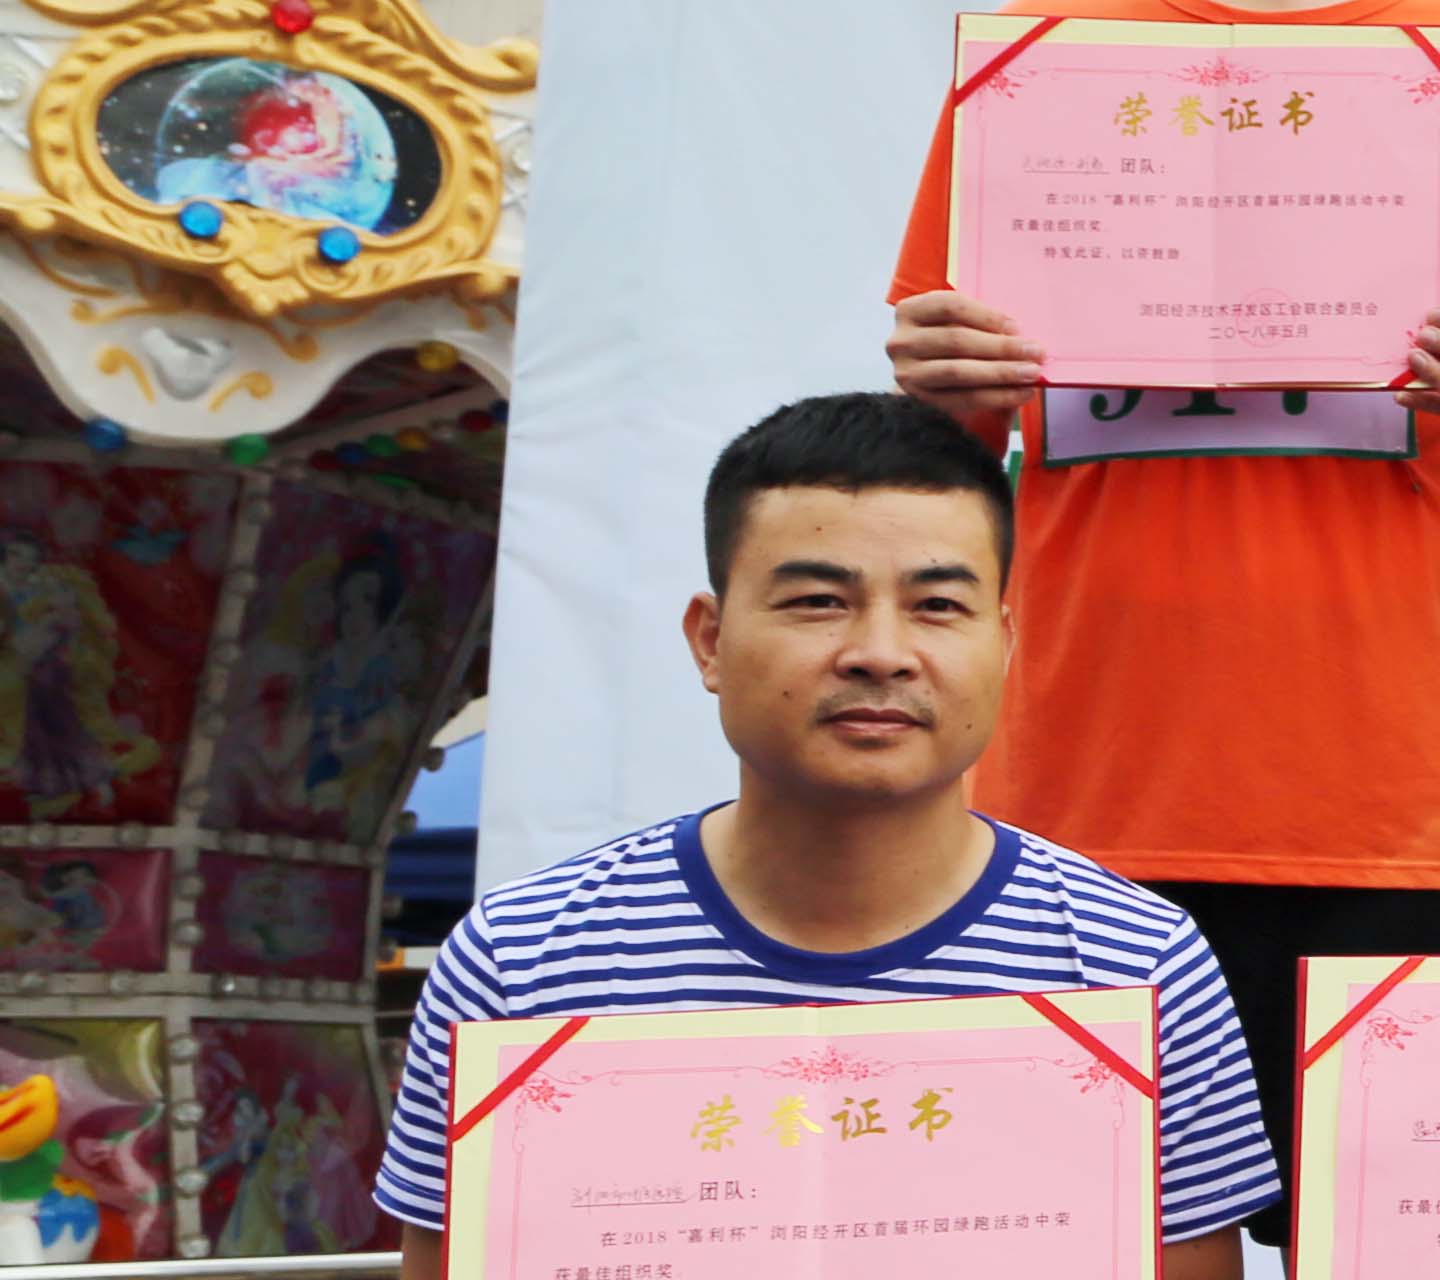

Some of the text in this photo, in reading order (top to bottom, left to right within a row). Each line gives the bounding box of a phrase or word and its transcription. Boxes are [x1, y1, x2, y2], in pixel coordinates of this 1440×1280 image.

[1112, 91, 1317, 138] 荣誉证书
[688, 1086, 956, 1153] 荣誉证书
